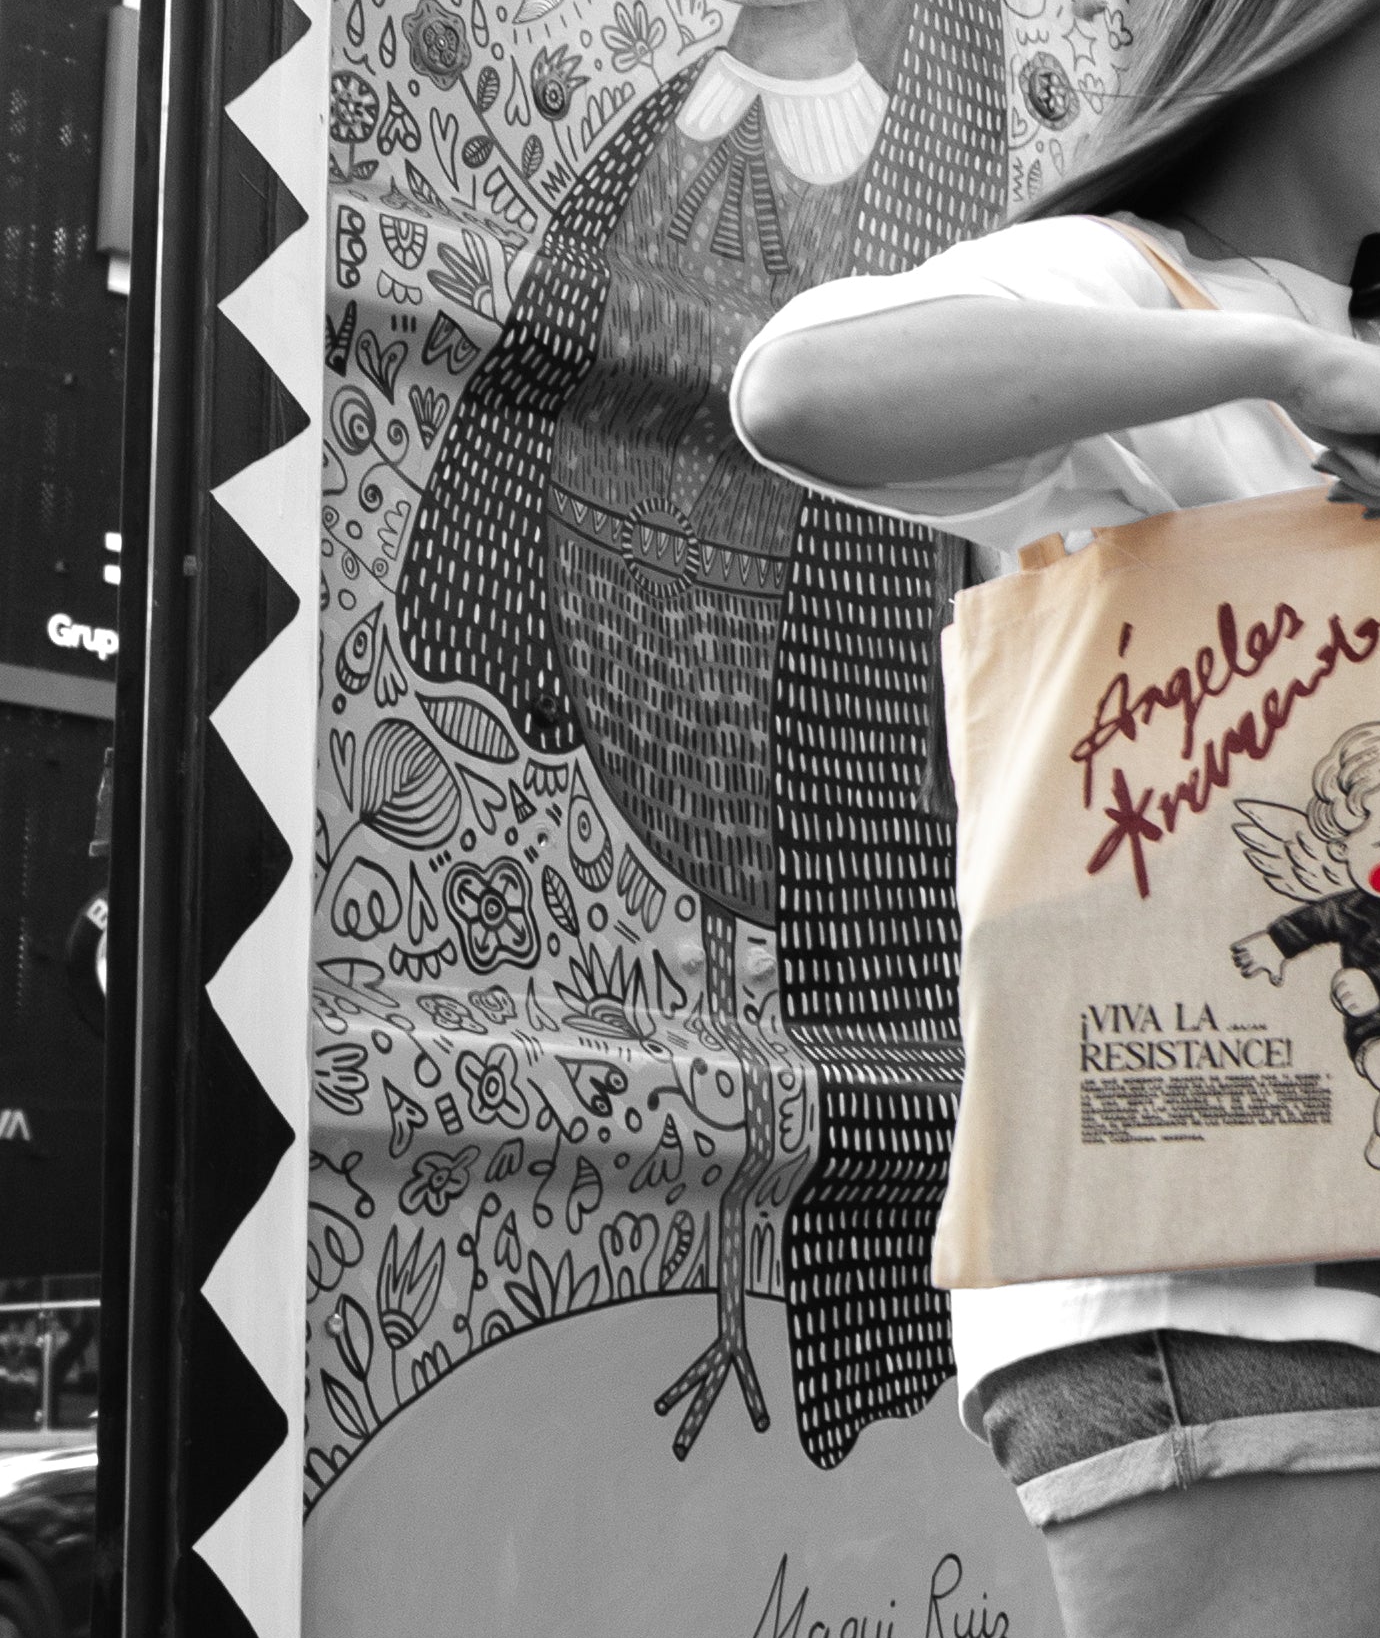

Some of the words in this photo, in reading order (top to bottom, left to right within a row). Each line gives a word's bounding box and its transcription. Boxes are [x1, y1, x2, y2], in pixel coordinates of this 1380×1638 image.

[1070, 602, 1304, 810] Ángeles
[1080, 1003, 1163, 1041] ¡VIVA
[1175, 1001, 1220, 1033] LA
[1079, 1037, 1293, 1072] RESISTANCE!
